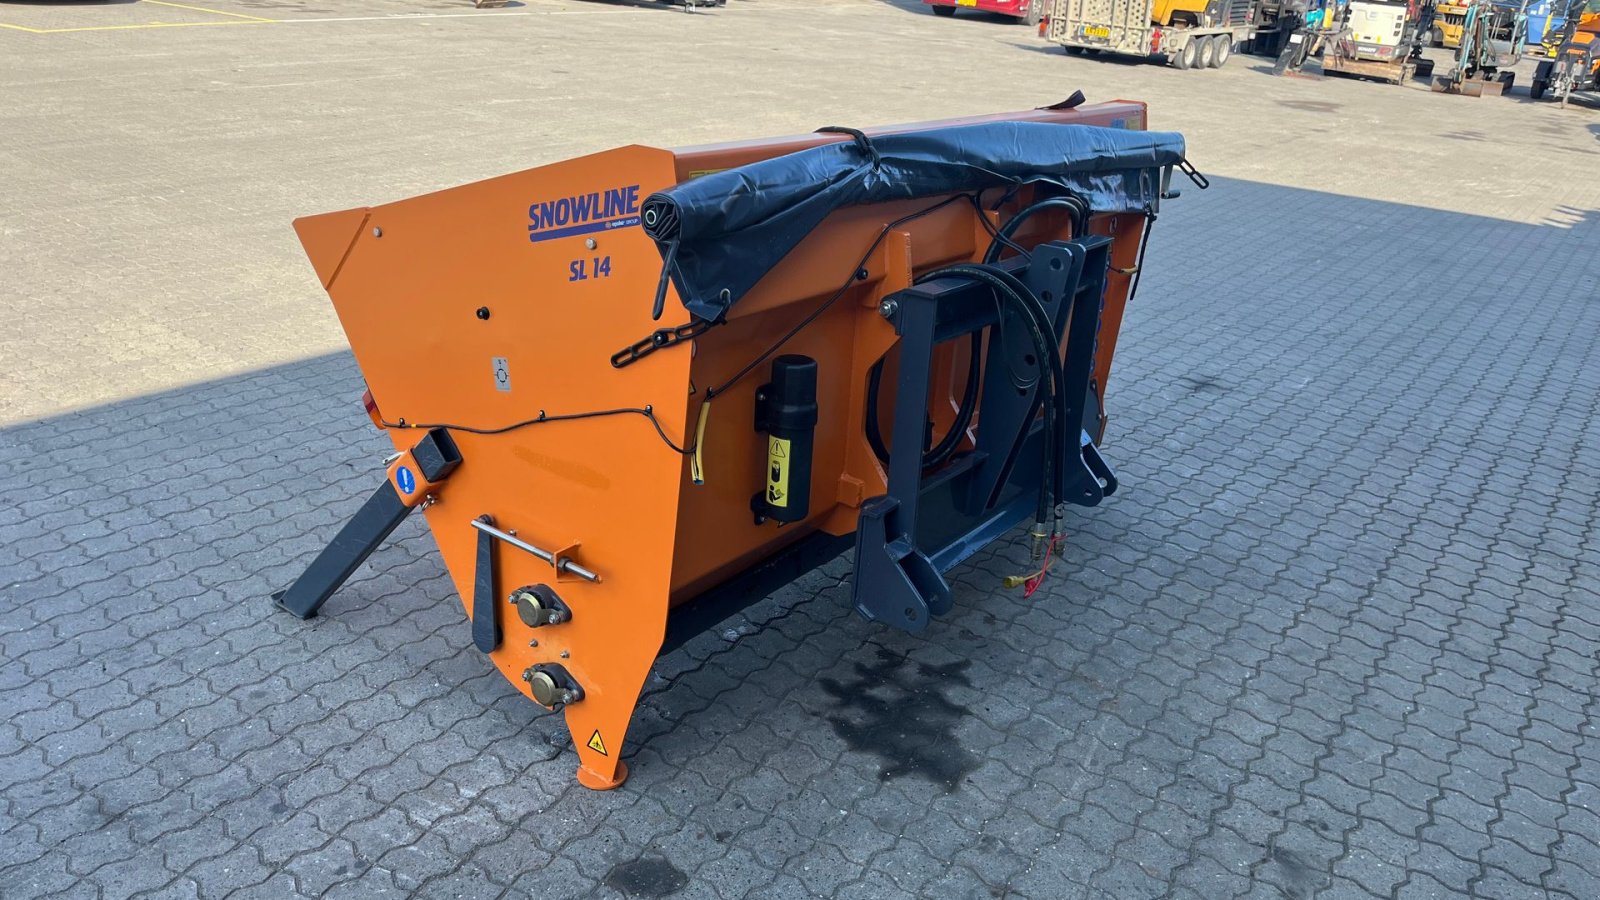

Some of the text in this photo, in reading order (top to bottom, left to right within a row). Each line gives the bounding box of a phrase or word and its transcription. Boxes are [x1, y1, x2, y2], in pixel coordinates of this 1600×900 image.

[528, 185, 640, 231] SNOWLINE
[569, 256, 611, 281] SL 14
